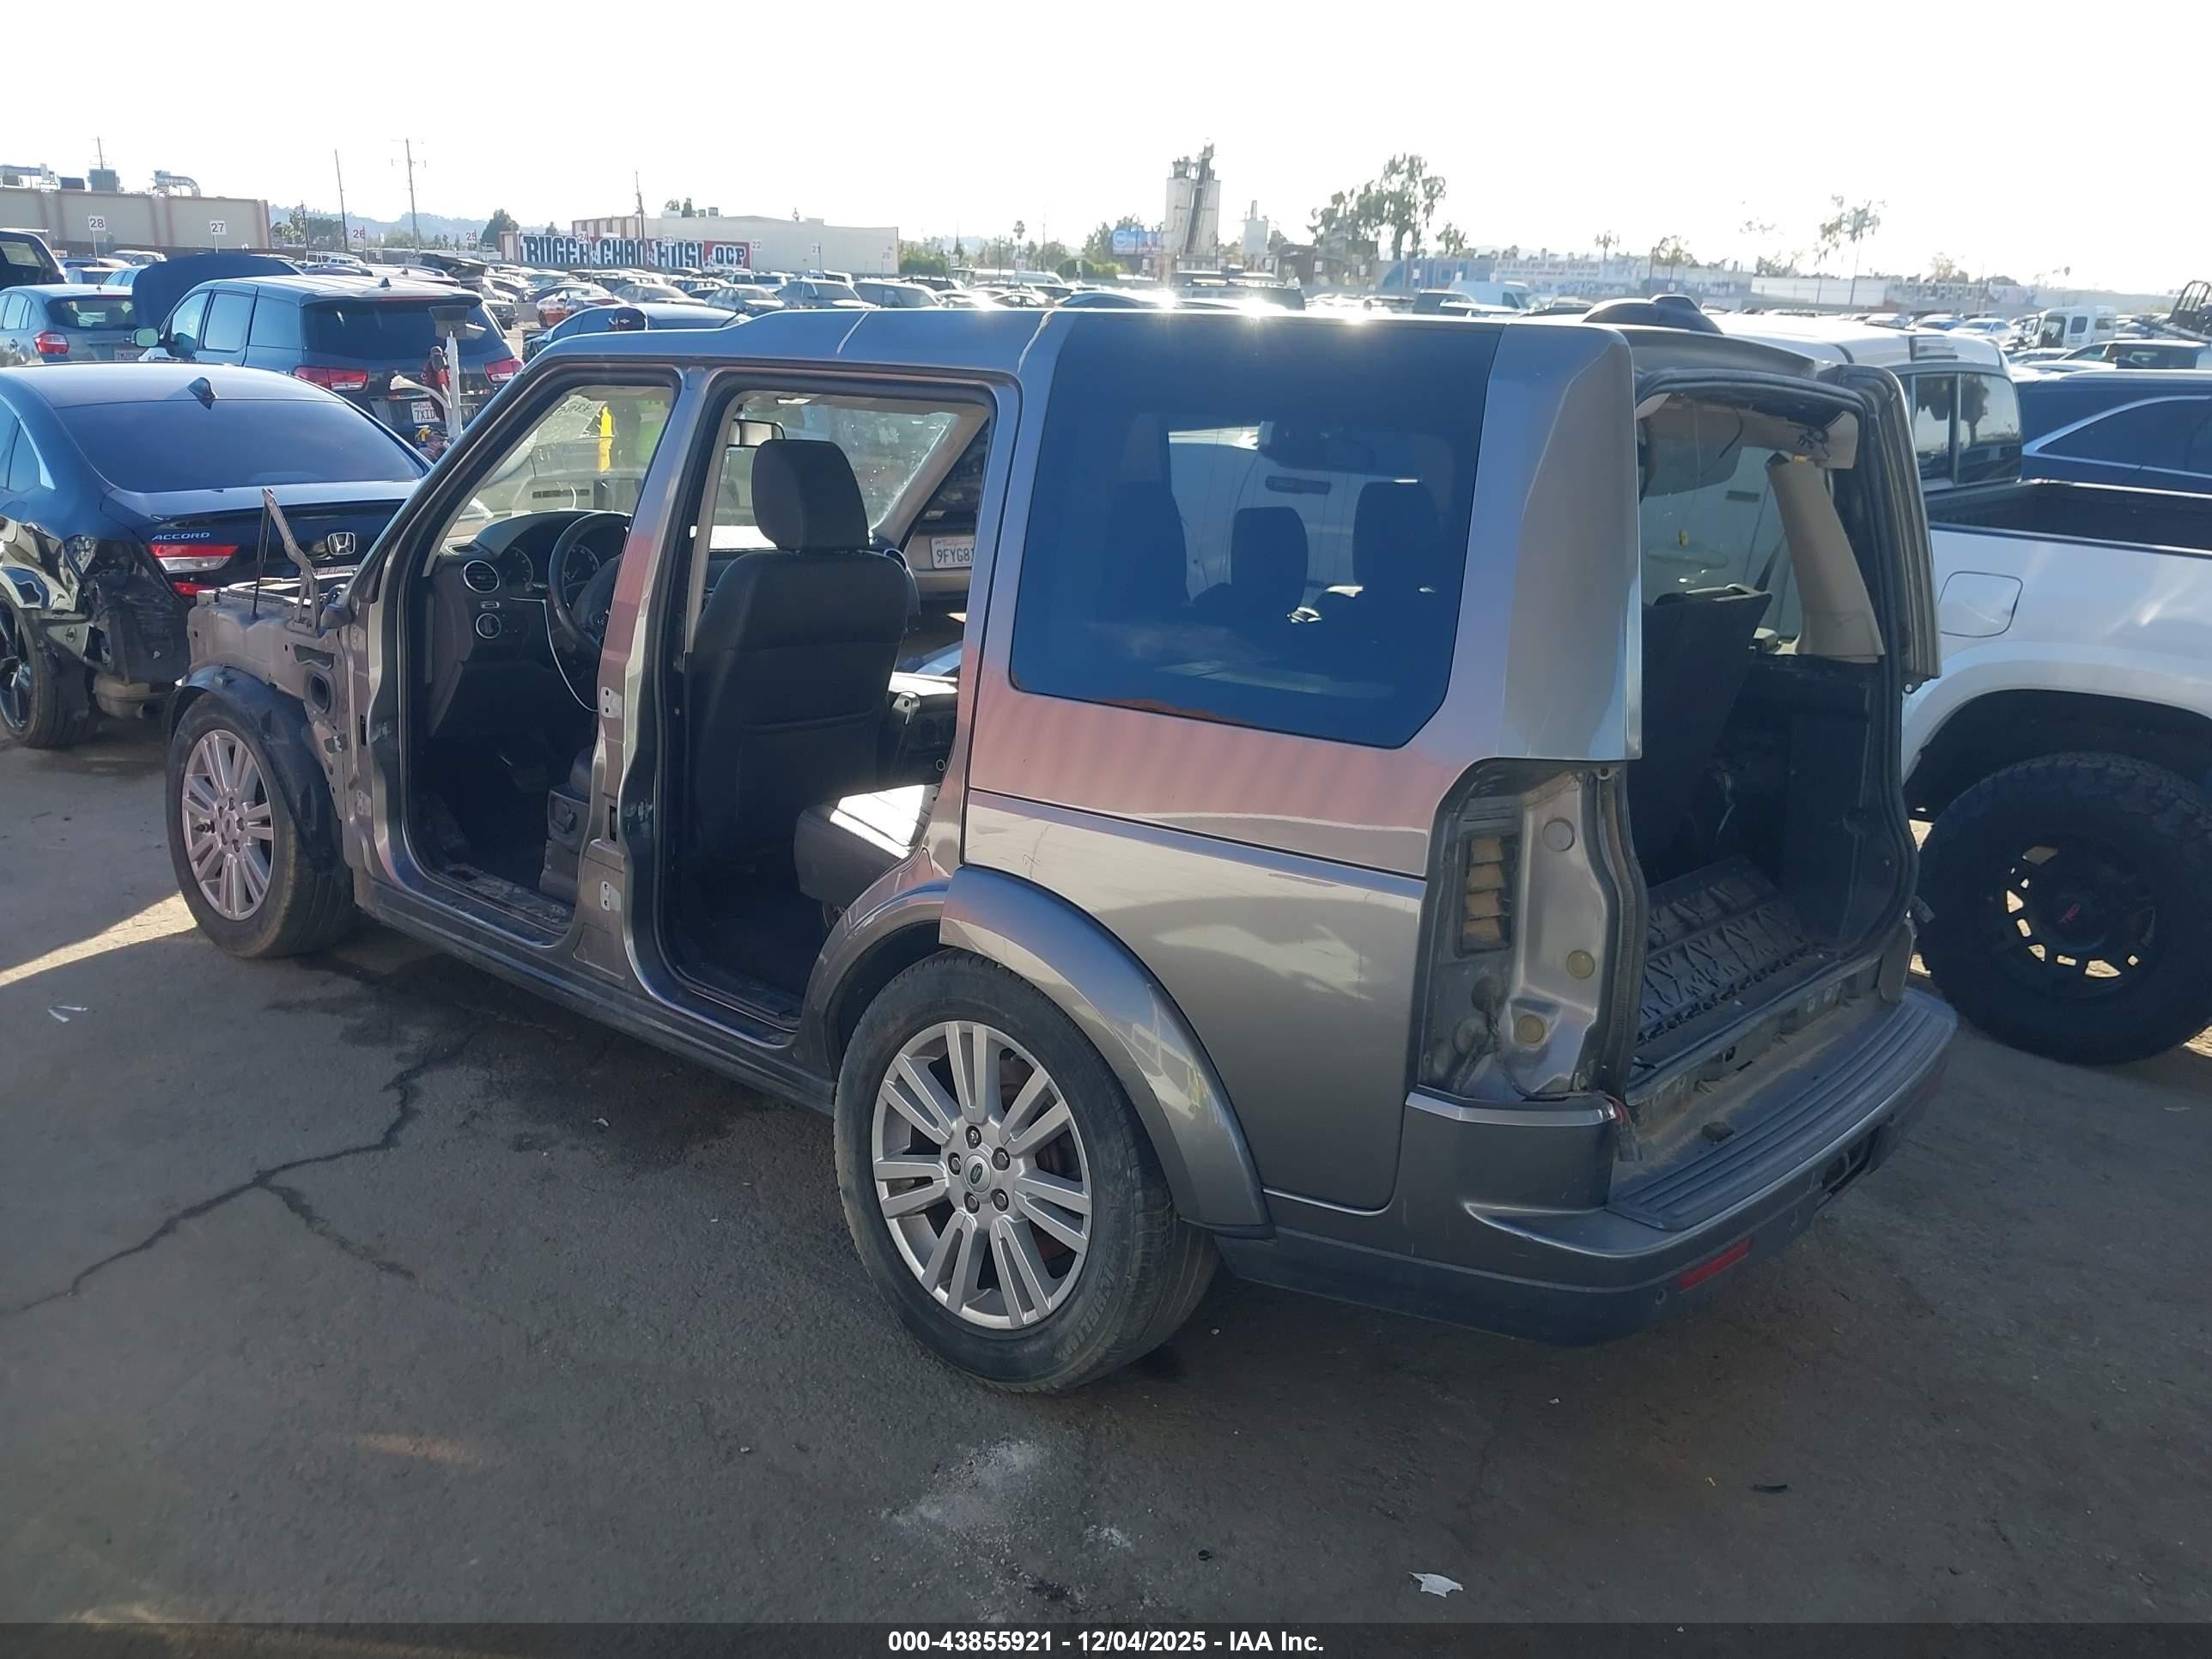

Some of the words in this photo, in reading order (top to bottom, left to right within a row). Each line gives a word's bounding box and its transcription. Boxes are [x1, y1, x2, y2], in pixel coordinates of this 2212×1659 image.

[89, 218, 105, 228] 28
[210, 222, 224, 233] 27
[353, 229, 365, 239] 26
[465, 232, 477, 241] 25
[151, 531, 210, 542] ACCORD
